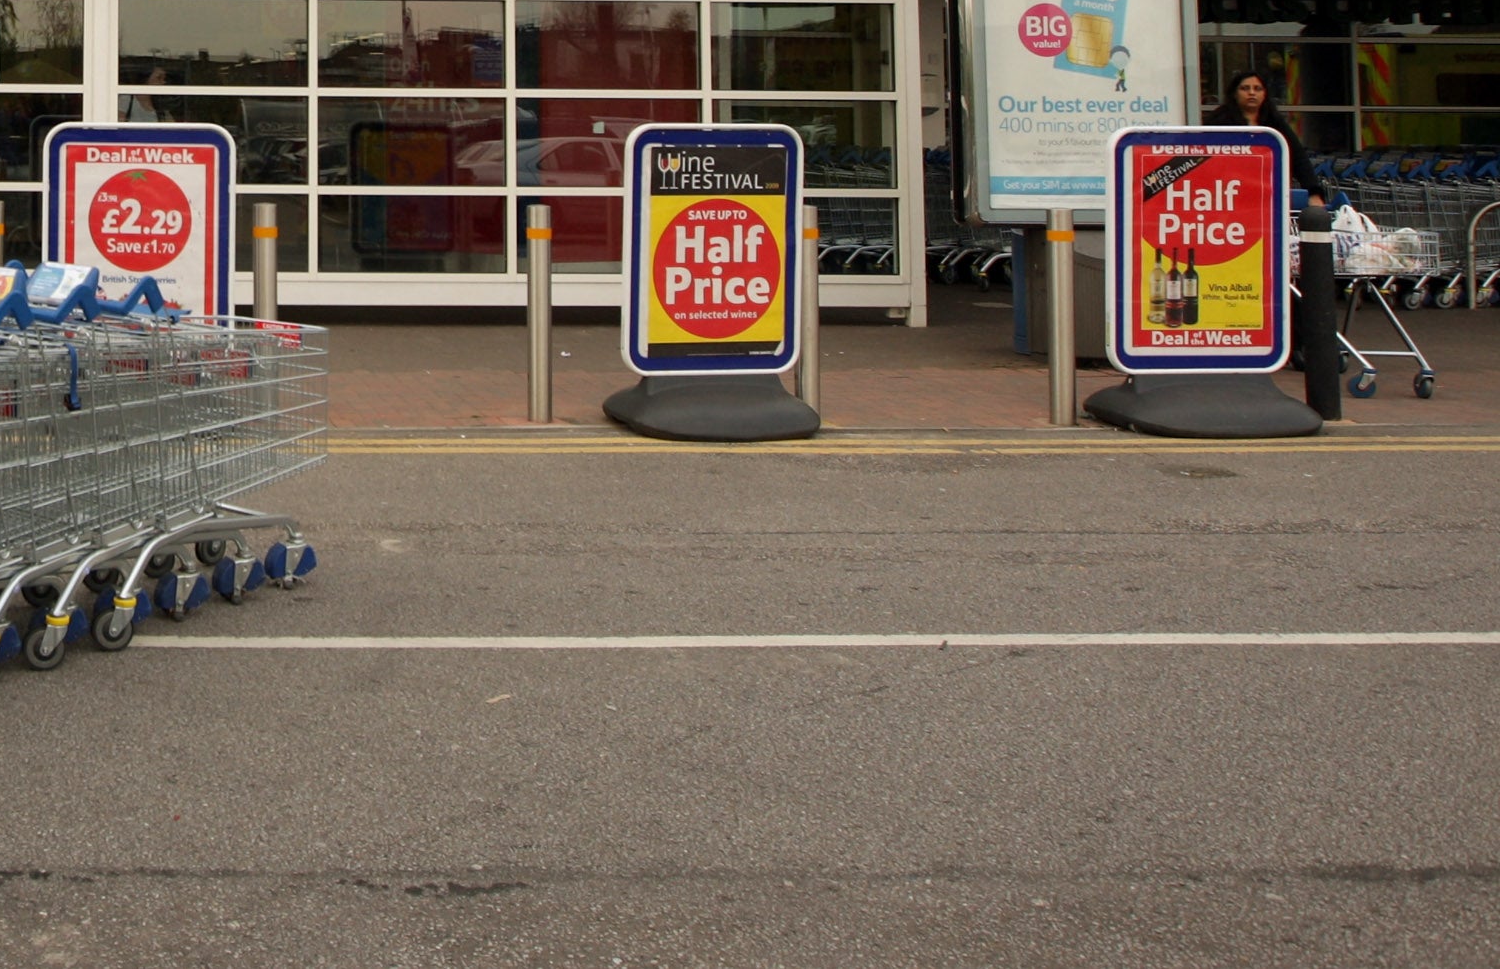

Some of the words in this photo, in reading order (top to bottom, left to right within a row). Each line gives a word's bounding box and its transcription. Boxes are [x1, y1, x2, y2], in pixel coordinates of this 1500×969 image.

[1082, 0, 1114, 12] month
[1025, 16, 1067, 37] BIG
[1033, 39, 1061, 49] value!
[998, 96, 1036, 113] Our
[1042, 95, 1082, 113] best
[1086, 99, 1125, 113] ever
[1130, 96, 1168, 113] deal
[999, 117, 1032, 132] 400
[1036, 117, 1074, 132] mins
[1078, 120, 1093, 132] or
[1097, 118, 1128, 132] 800
[86, 147, 128, 163] Deal
[144, 148, 194, 164] Week
[1152, 145, 1189, 155] Deal
[1205, 145, 1253, 155] Week
[657, 151, 715, 181] Wine
[1160, 158, 1198, 188] FESTIVAL
[681, 174, 764, 190] FESTIVAL
[1003, 180, 1020, 189] Get
[1021, 181, 1041, 191] your
[1043, 180, 1059, 189] SIM
[1061, 181, 1071, 189] at
[1166, 180, 1241, 211] Half
[101, 198, 183, 235] £2.29
[688, 210, 716, 220] SAVE
[717, 210, 733, 219] UP
[733, 210, 747, 220] TO
[1159, 213, 1246, 246] Price
[107, 238, 141, 254] Save
[143, 239, 176, 255] £1.70
[675, 225, 765, 264] Half
[102, 275, 127, 283] British
[665, 265, 770, 305] Price
[1229, 284, 1253, 292] Albali
[674, 311, 687, 320] on
[689, 310, 728, 320] selected
[731, 310, 757, 319] wines
[1151, 330, 1190, 346] Deal
[1190, 338, 1205, 346] the
[1205, 330, 1252, 346] Week
